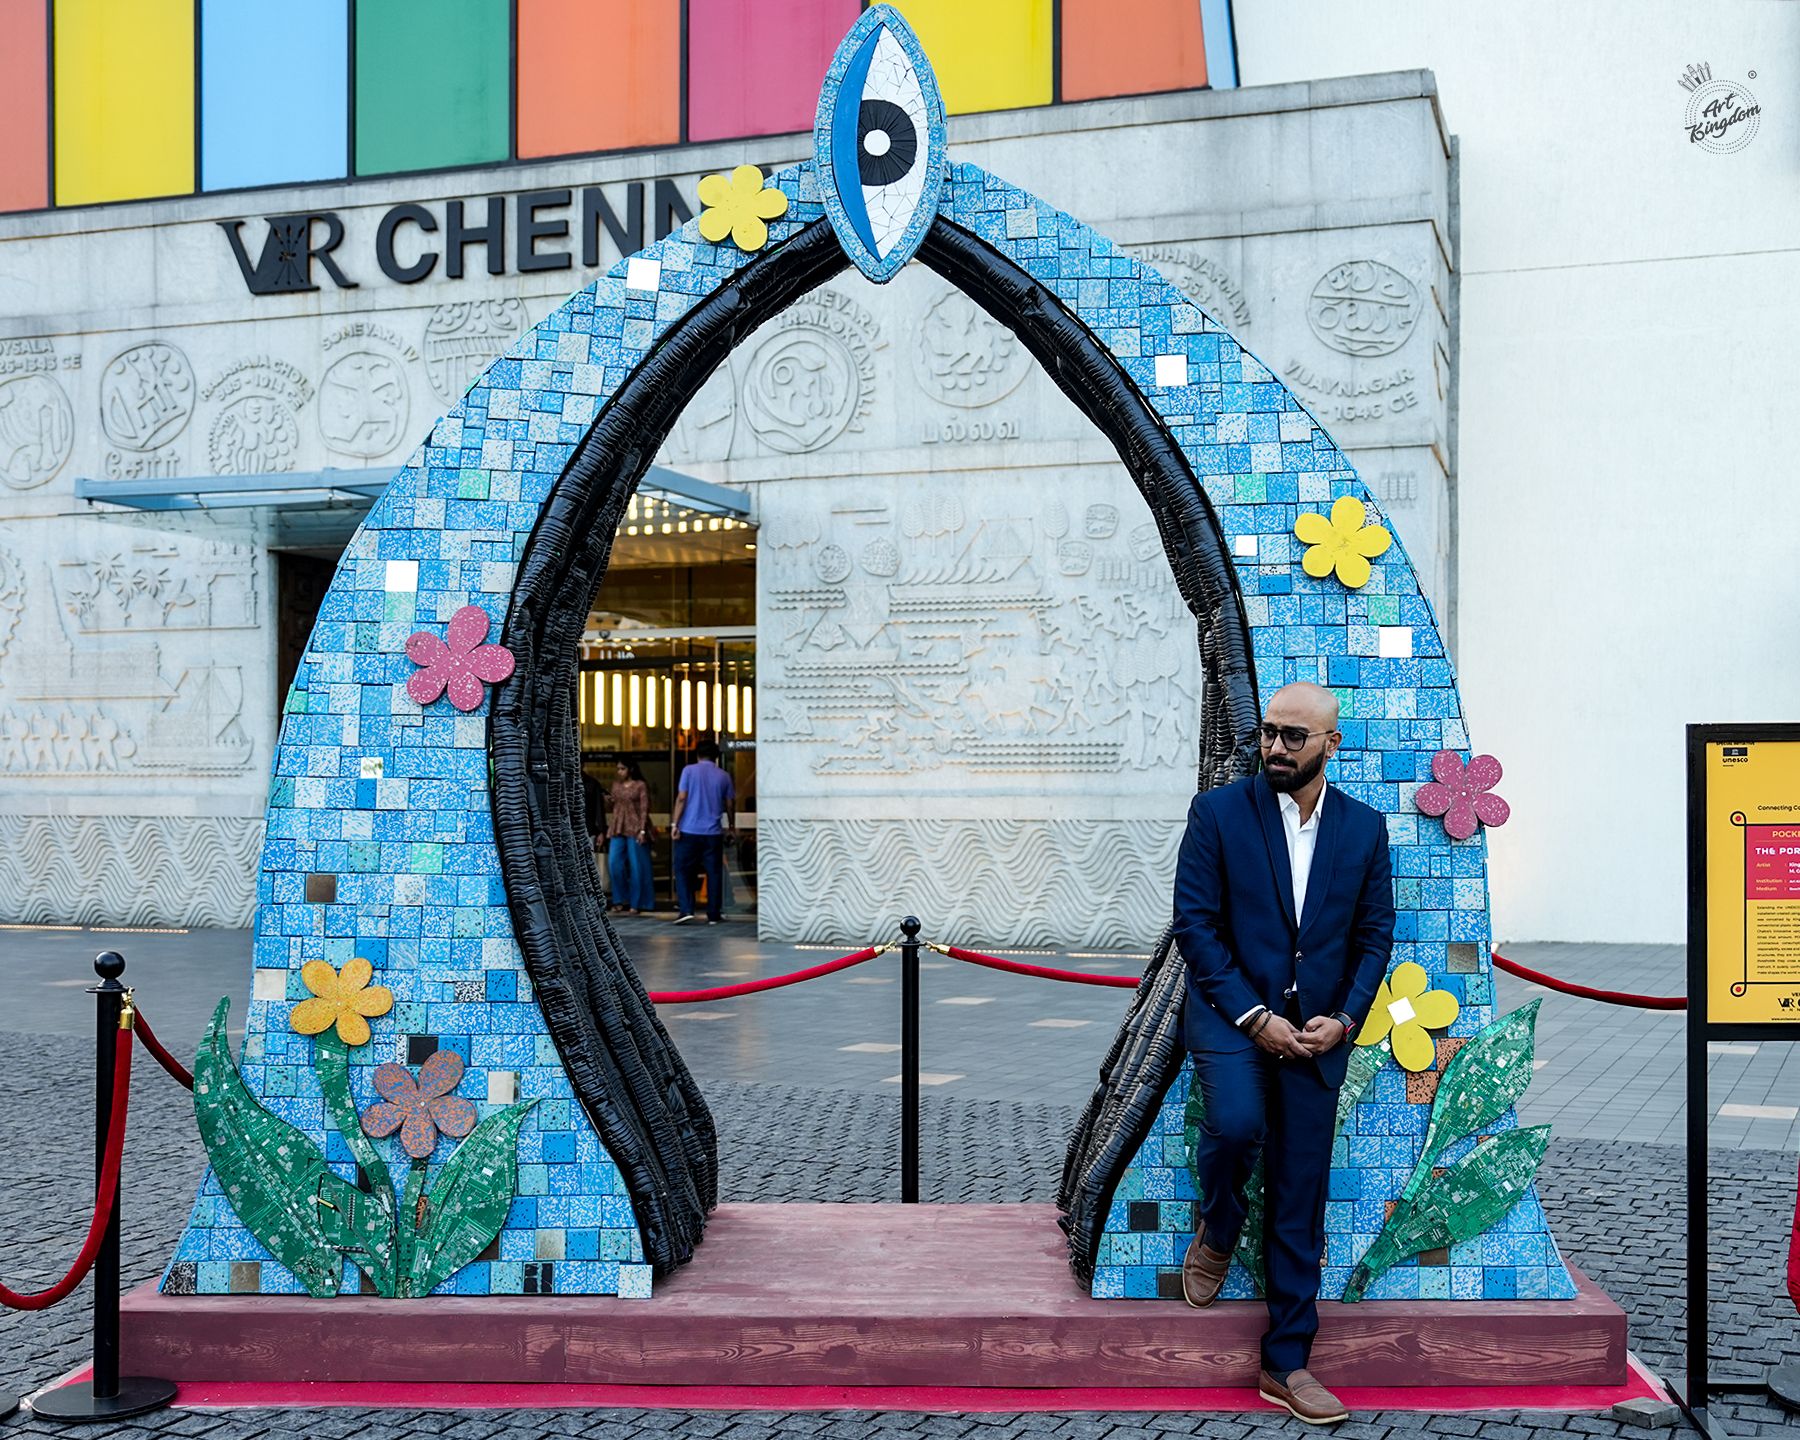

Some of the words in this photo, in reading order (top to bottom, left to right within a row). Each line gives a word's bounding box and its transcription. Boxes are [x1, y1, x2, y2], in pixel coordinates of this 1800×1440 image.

[216, 211, 360, 296] VR
[375, 167, 773, 285] CHENN
[795, 288, 881, 341] MEVARA
[1757, 804, 1793, 812] Connecting
[1755, 847, 1776, 855] THE
